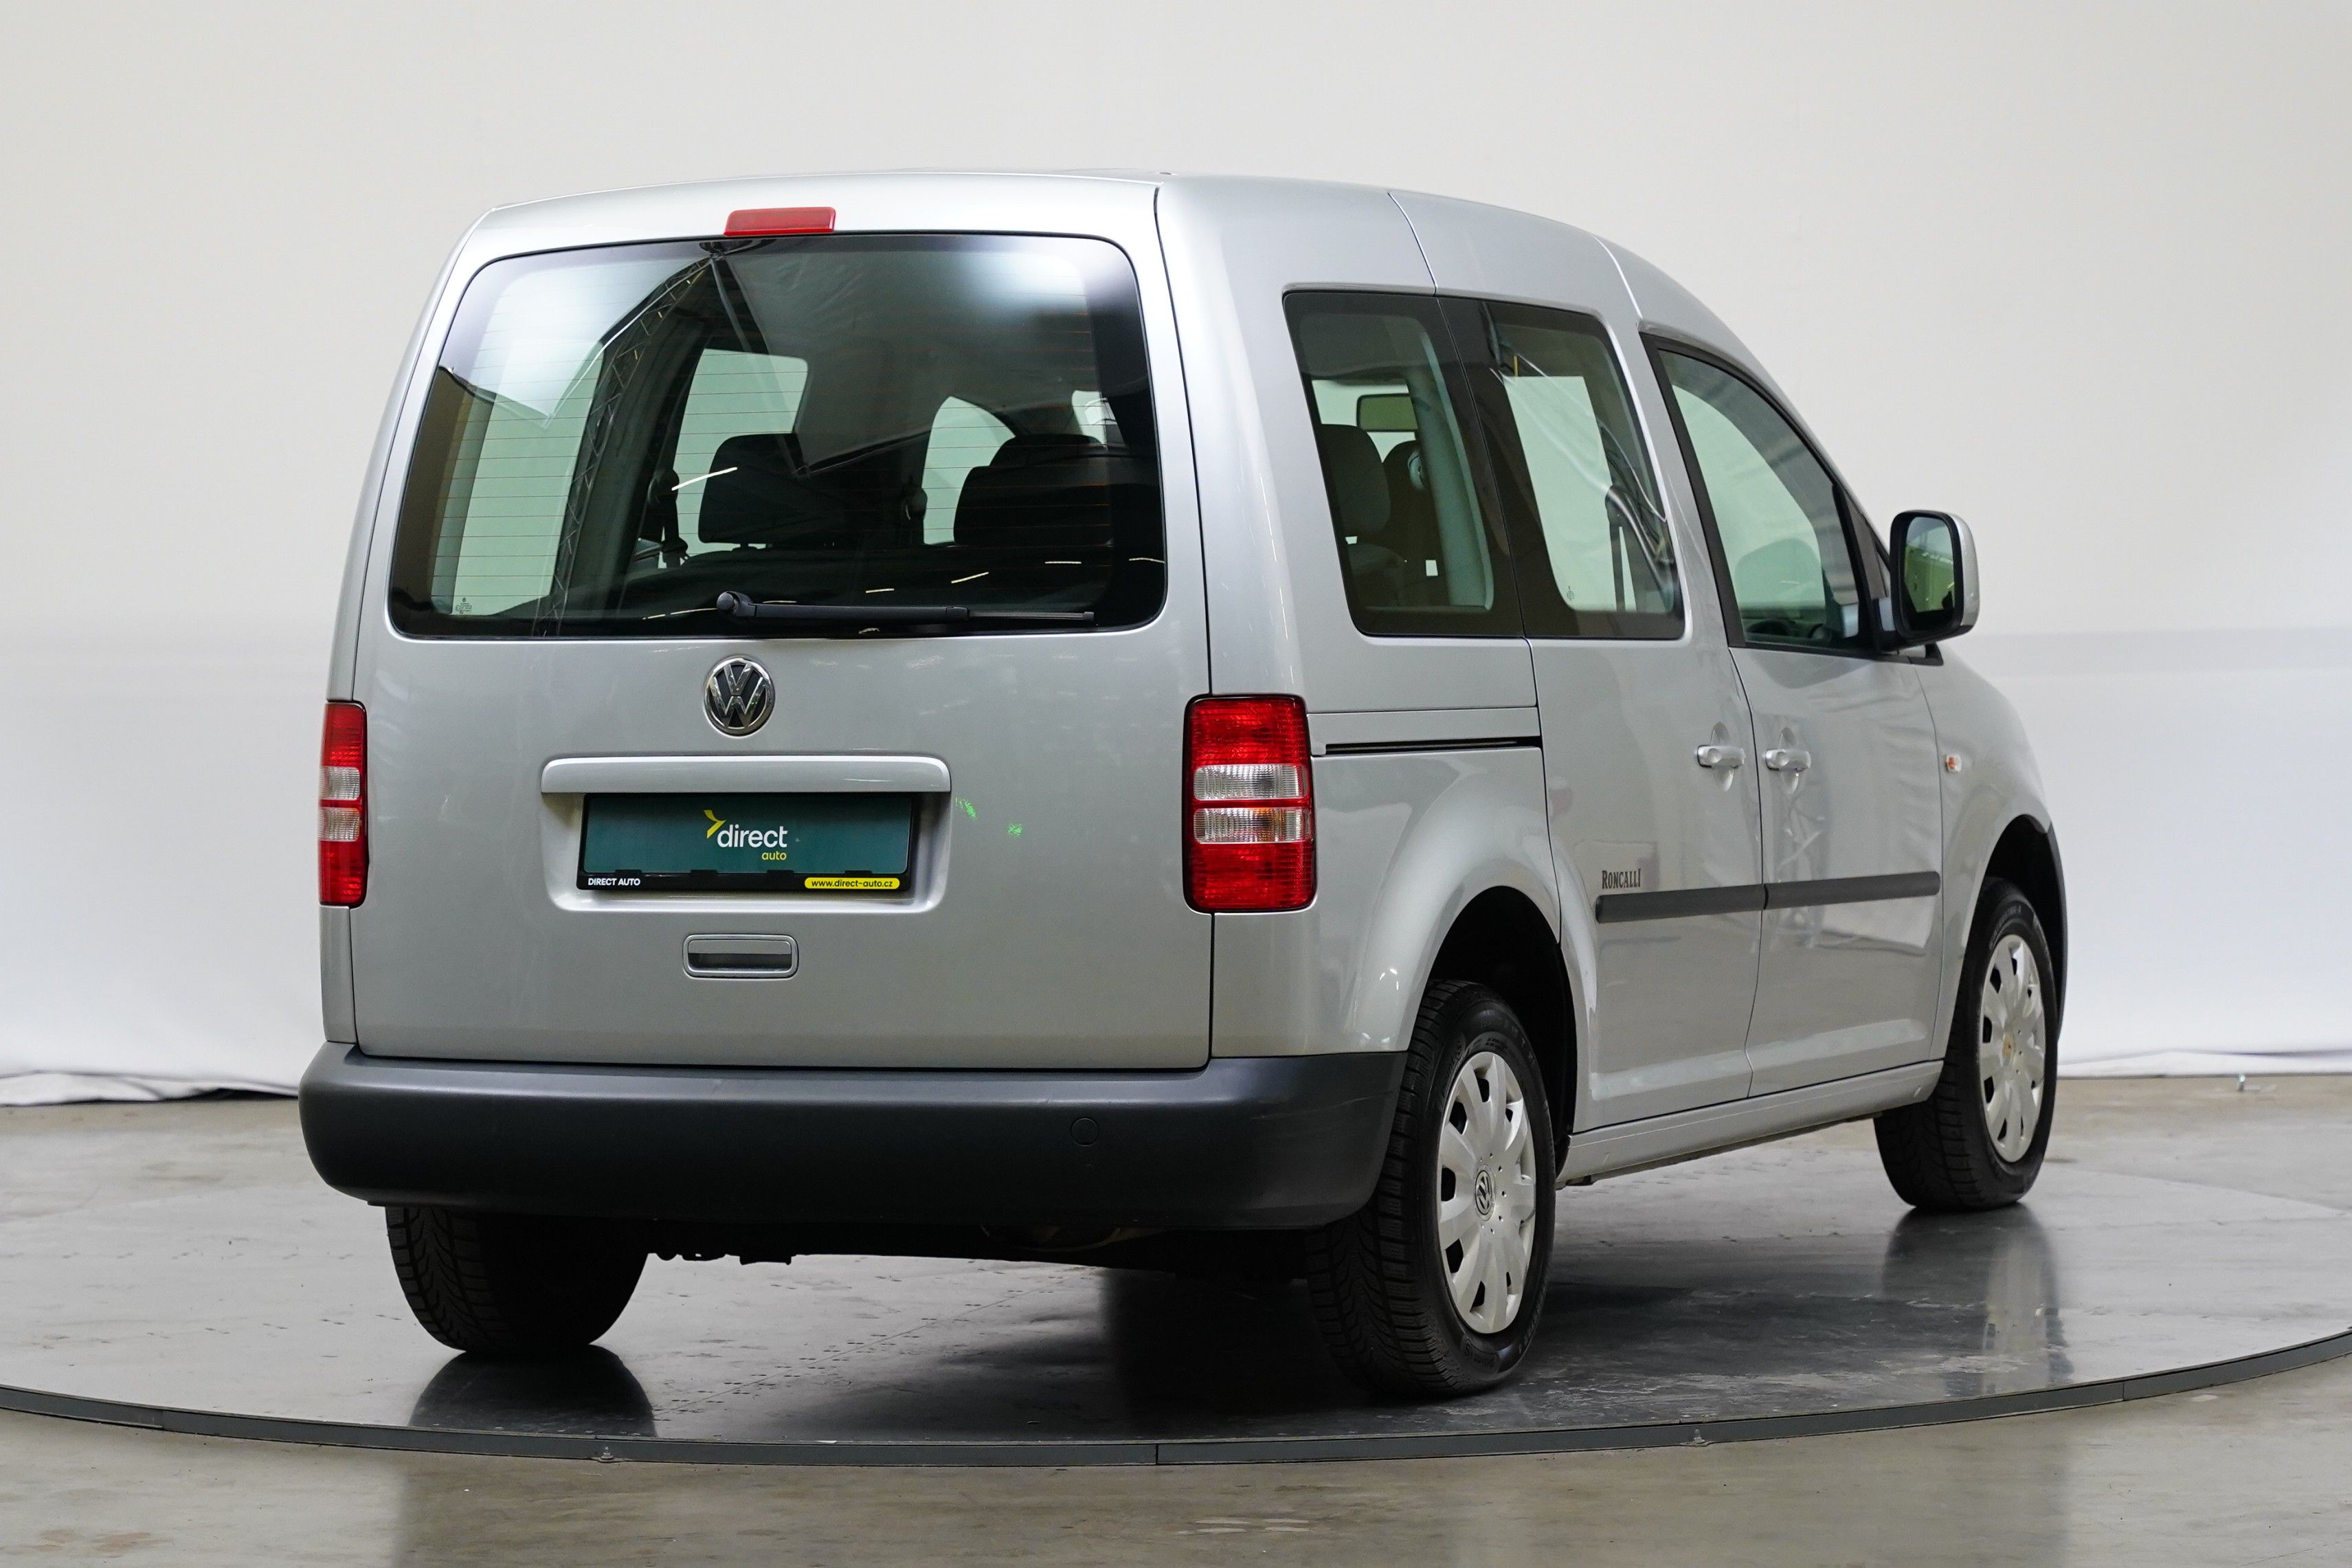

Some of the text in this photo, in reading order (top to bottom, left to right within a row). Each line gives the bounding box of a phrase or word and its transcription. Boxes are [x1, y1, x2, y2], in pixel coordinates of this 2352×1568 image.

[717, 824, 788, 848] direct
[761, 851, 787, 860] auto
[588, 877, 640, 886] DIRECT AUTO
[1602, 869, 1641, 889] RONCALLI
